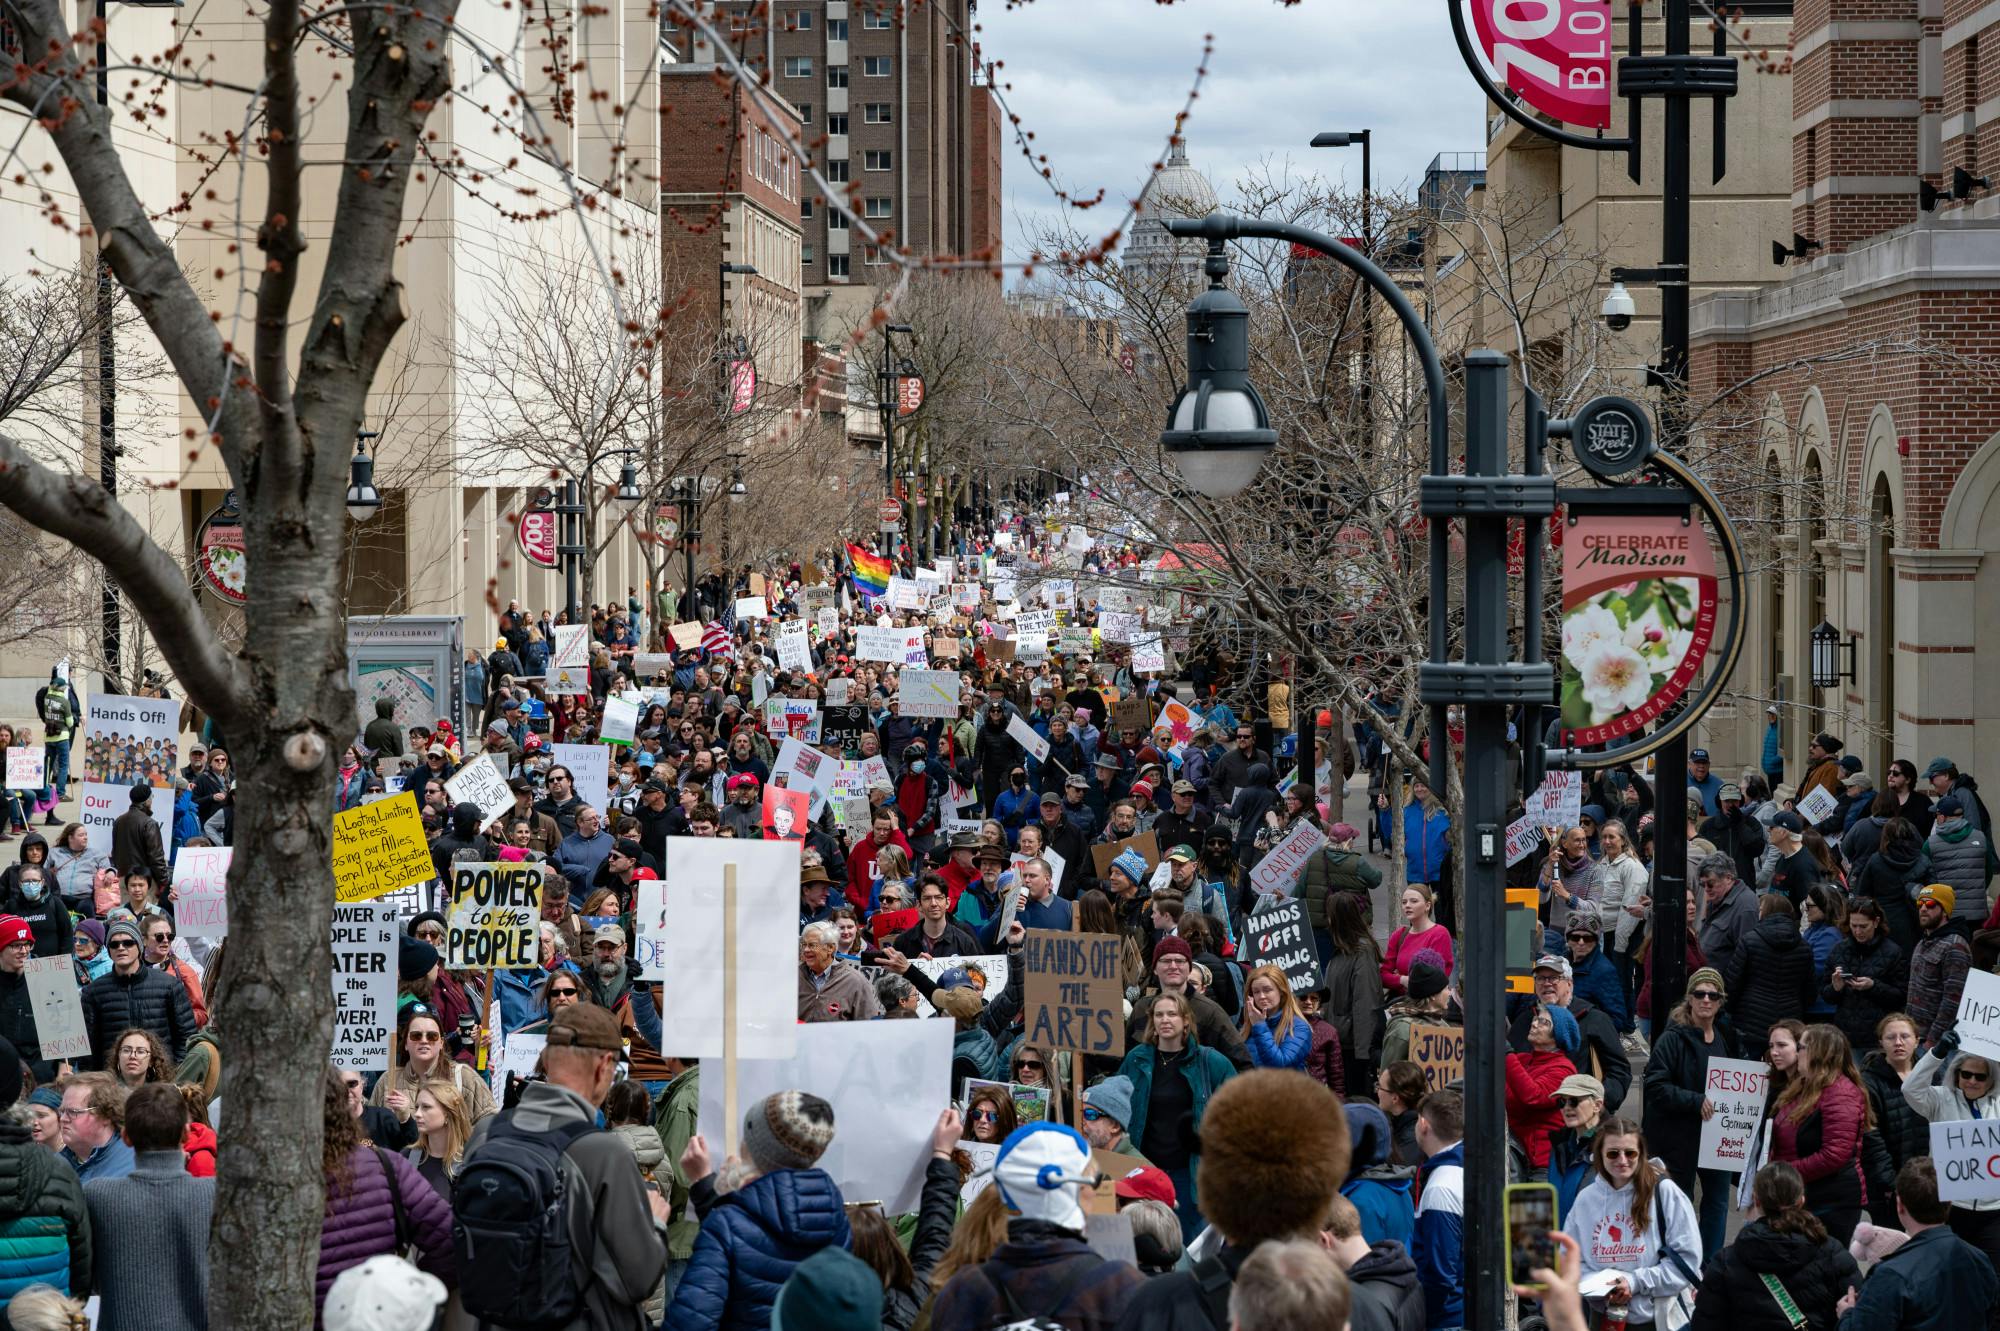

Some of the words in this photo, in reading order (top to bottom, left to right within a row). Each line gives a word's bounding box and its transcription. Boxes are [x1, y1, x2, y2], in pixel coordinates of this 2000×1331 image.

[1568, 0, 1605, 89] BLO
[900, 383, 908, 409] BLOCK
[908, 378, 920, 409] 600
[1588, 421, 1629, 439] STATE
[1588, 437, 1626, 452] Street
[526, 514, 544, 554] 700
[543, 522, 553, 556] BLOCK
[1582, 535, 1689, 550] CELEBRATE
[1576, 546, 1687, 569] Madison
[1017, 612, 1039, 622] DOWN
[1042, 610, 1053, 618] W/
[1018, 622, 1034, 631] THE
[1035, 619, 1056, 629] TURD
[1106, 614, 1136, 627] POWER
[783, 626, 803, 635] YOUR
[1103, 629, 1130, 640] PEOPL
[782, 638, 794, 646] NO
[934, 640, 956, 650] FELON
[905, 651, 926, 663] ANIZE
[901, 671, 931, 683] HANDS
[1586, 679, 1685, 742] CELEBRATE
[1684, 599, 1714, 671] SPRING
[920, 689, 935, 697] OUR
[91, 707, 135, 722] Hands
[140, 711, 166, 725] Off!
[784, 701, 812, 714] AMERICA
[899, 702, 957, 716] CONSTITUTION
[564, 752, 601, 761] LIBERTY
[456, 760, 496, 796] HANDS
[85, 795, 112, 809] Our
[1543, 790, 1562, 810] OFF!
[376, 802, 413, 822] Limiting
[339, 833, 357, 845] the
[359, 825, 388, 840] Press
[1505, 822, 1524, 839] NDS
[1517, 825, 1545, 850] HISTO
[1286, 827, 1320, 857] RETIRE
[185, 854, 232, 874] TRU
[332, 852, 361, 868] osing
[364, 845, 380, 856] our
[389, 847, 429, 867] Education
[179, 878, 207, 897] CAN
[336, 874, 380, 901] Judicial
[384, 861, 431, 887] Systems
[454, 869, 542, 907] POWER
[331, 907, 374, 923] OWER
[382, 909, 396, 922] of
[470, 907, 491, 926] to
[497, 908, 530, 927] the
[1247, 904, 1301, 934] HANDS
[17, 929, 28, 938] W
[331, 927, 366, 943] OPLE
[379, 929, 391, 943] is
[1258, 924, 1301, 952] OFF!
[449, 928, 533, 966] PEOPLE
[24, 959, 41, 975] END
[49, 955, 67, 971] THE
[331, 952, 386, 973] ATER
[1026, 937, 1087, 976] HANDS
[1090, 940, 1120, 979] OFF
[346, 977, 367, 990] the
[1287, 972, 1315, 993] NDS
[362, 992, 375, 1007] in
[1059, 982, 1090, 1006] THE
[335, 1010, 377, 1025] WER!
[1962, 998, 2000, 1030] IMP
[340, 1028, 387, 1043] ASAP
[1031, 1004, 1113, 1051] ARTS
[41, 1035, 90, 1058] FASCISM
[329, 1047, 354, 1056] CANS
[362, 1047, 387, 1056] HAVE
[1417, 1034, 1464, 1062] JUDG
[351, 1057, 369, 1065] GO!
[1708, 1069, 1768, 1097] RESIST
[1714, 1101, 1729, 1113] Like
[1721, 1116, 1754, 1139] Germany
[1716, 1147, 1745, 1159] fascists
[1721, 1137, 1744, 1149] Reject
[1946, 1157, 1985, 1181] OUR
